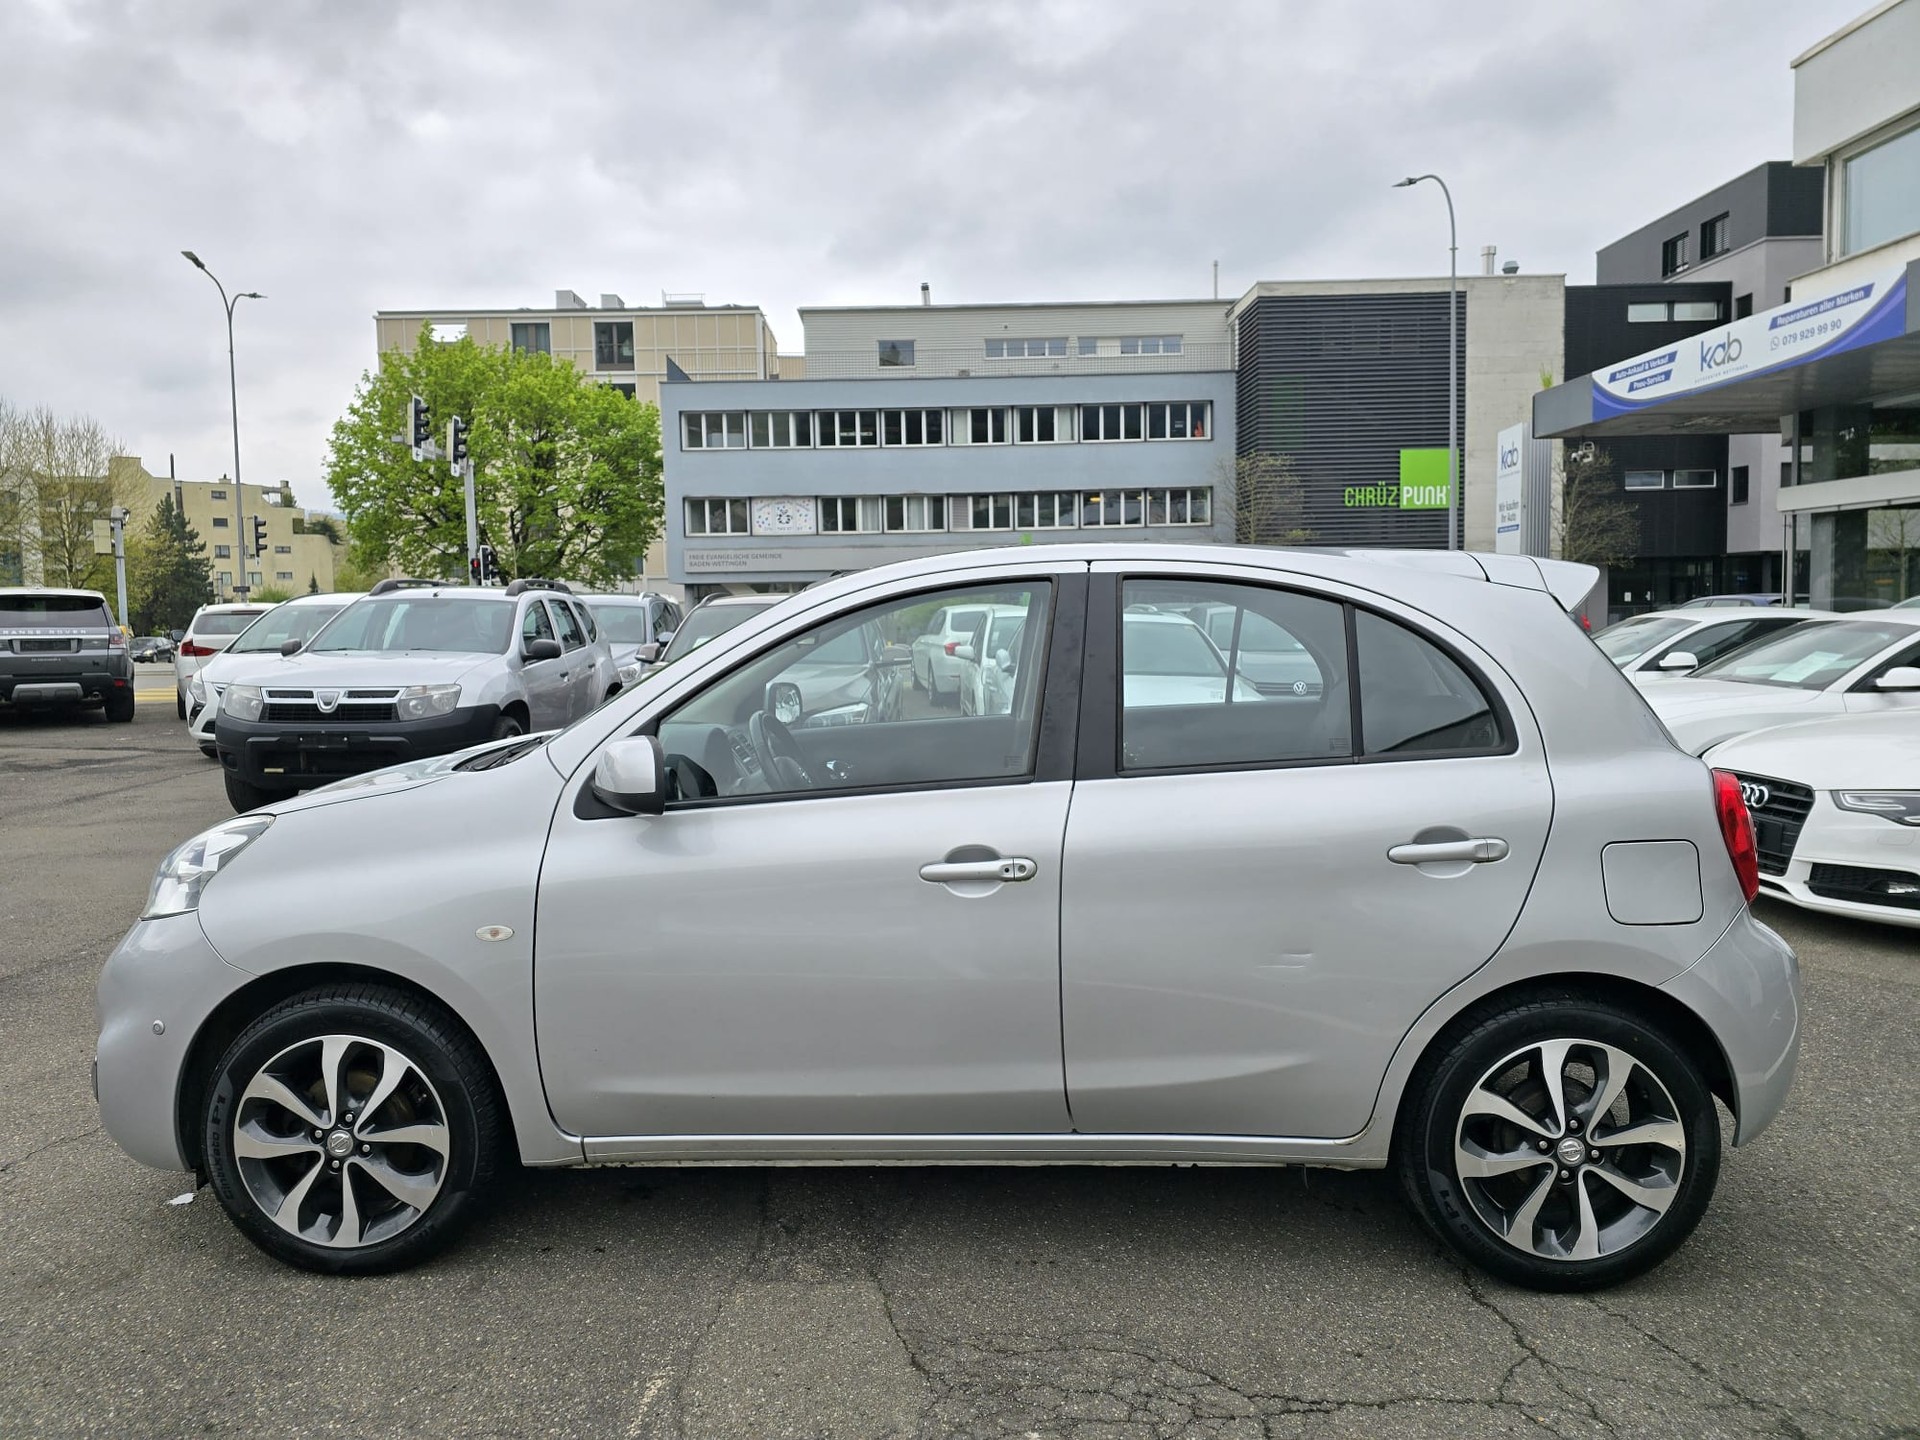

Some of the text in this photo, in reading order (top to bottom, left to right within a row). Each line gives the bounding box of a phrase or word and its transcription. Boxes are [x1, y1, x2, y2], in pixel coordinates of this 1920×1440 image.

[1777, 290, 1865, 326] Reparaturen aller Marken
[1782, 319, 1842, 346] 079 929 99 90
[1650, 355, 1669, 368] Verkauf
[1700, 331, 1742, 372] kab
[1501, 441, 1519, 470] kab
[1344, 481, 1451, 507] CHRÜZ PUNK
